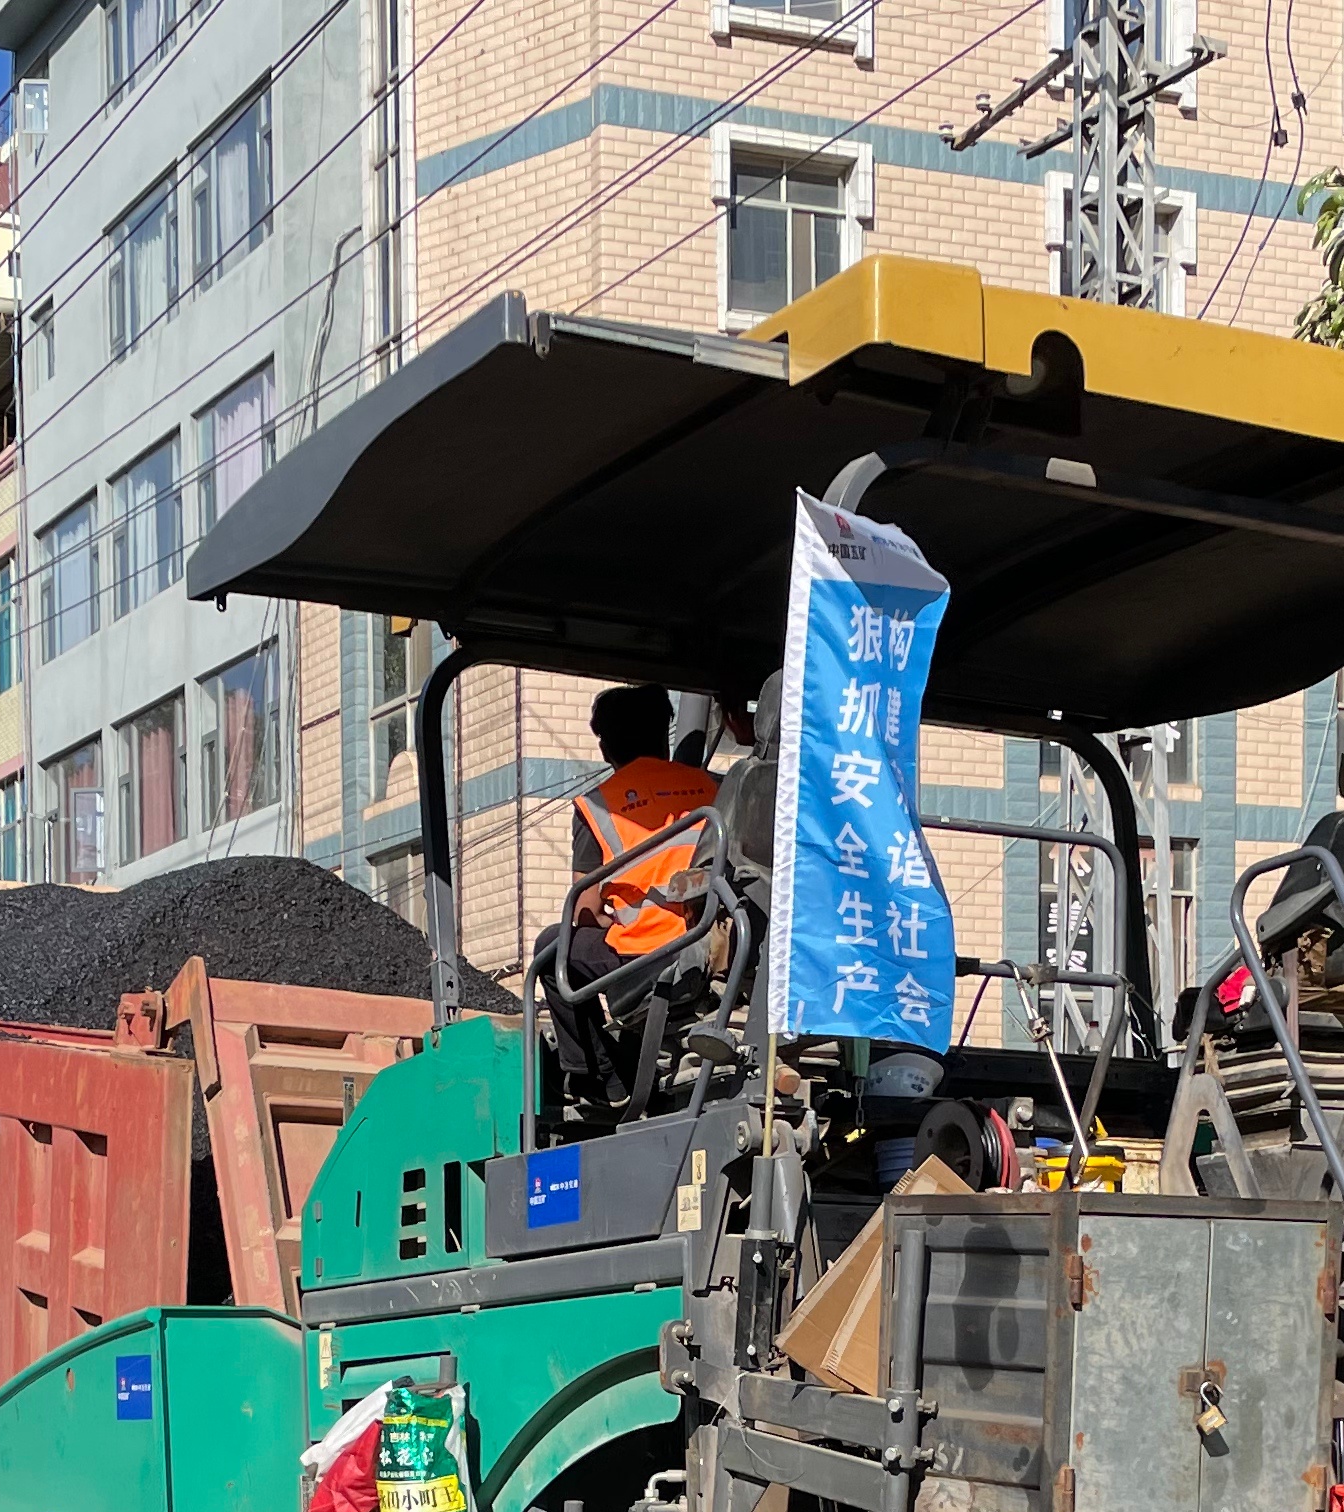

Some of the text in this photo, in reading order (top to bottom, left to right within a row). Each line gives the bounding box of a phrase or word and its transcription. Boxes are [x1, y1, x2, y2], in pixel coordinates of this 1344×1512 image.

[830, 603, 883, 1015] 狠抓安全生产
[884, 608, 933, 1028] 构建谐社会
